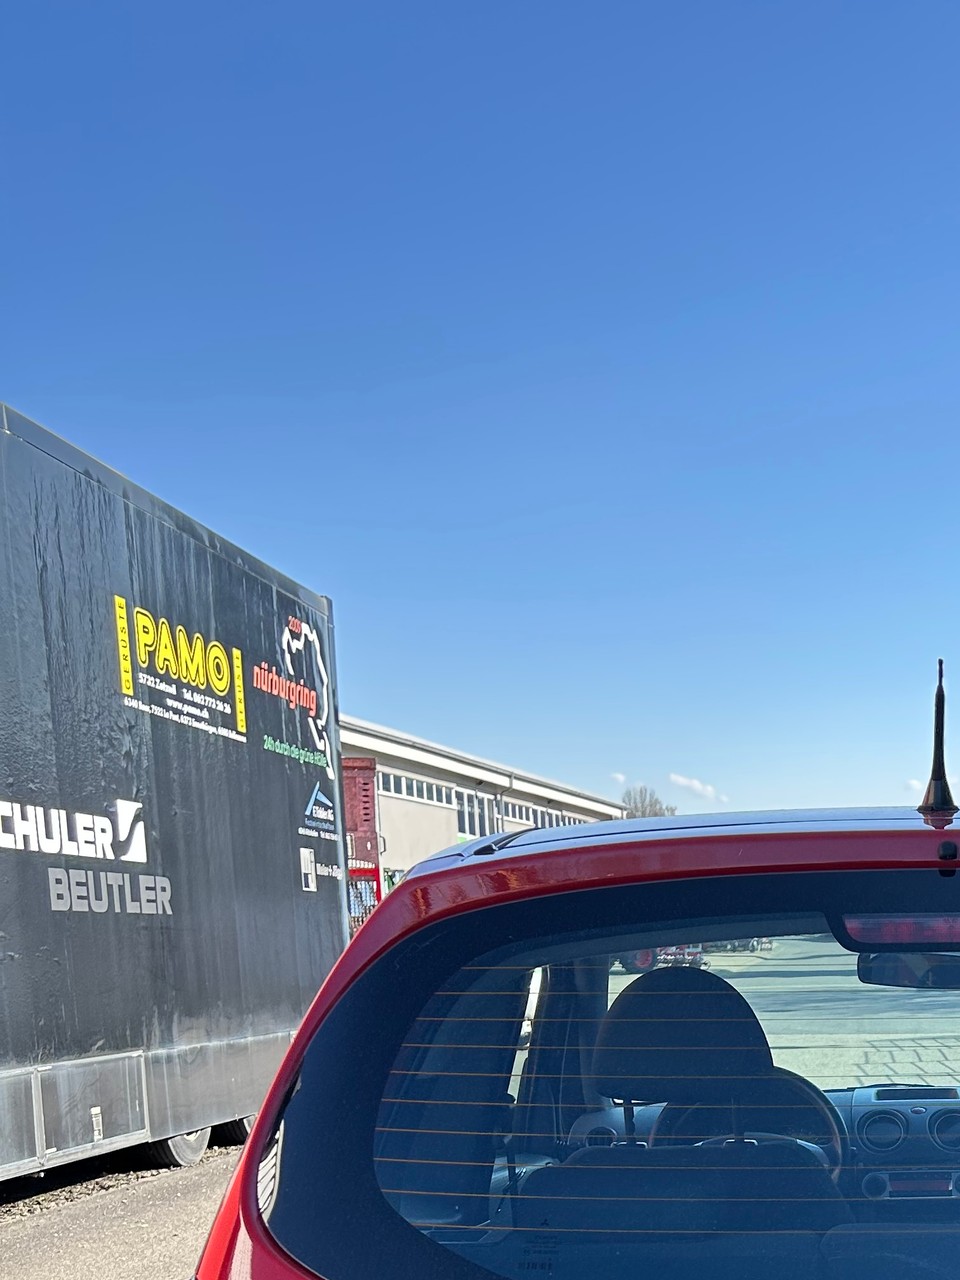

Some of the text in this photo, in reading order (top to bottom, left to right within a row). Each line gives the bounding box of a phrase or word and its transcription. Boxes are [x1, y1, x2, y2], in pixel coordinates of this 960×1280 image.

[133, 606, 231, 697] PAMO
[253, 661, 317, 716] nürburgring
[48, 867, 172, 915] BEUTLER
